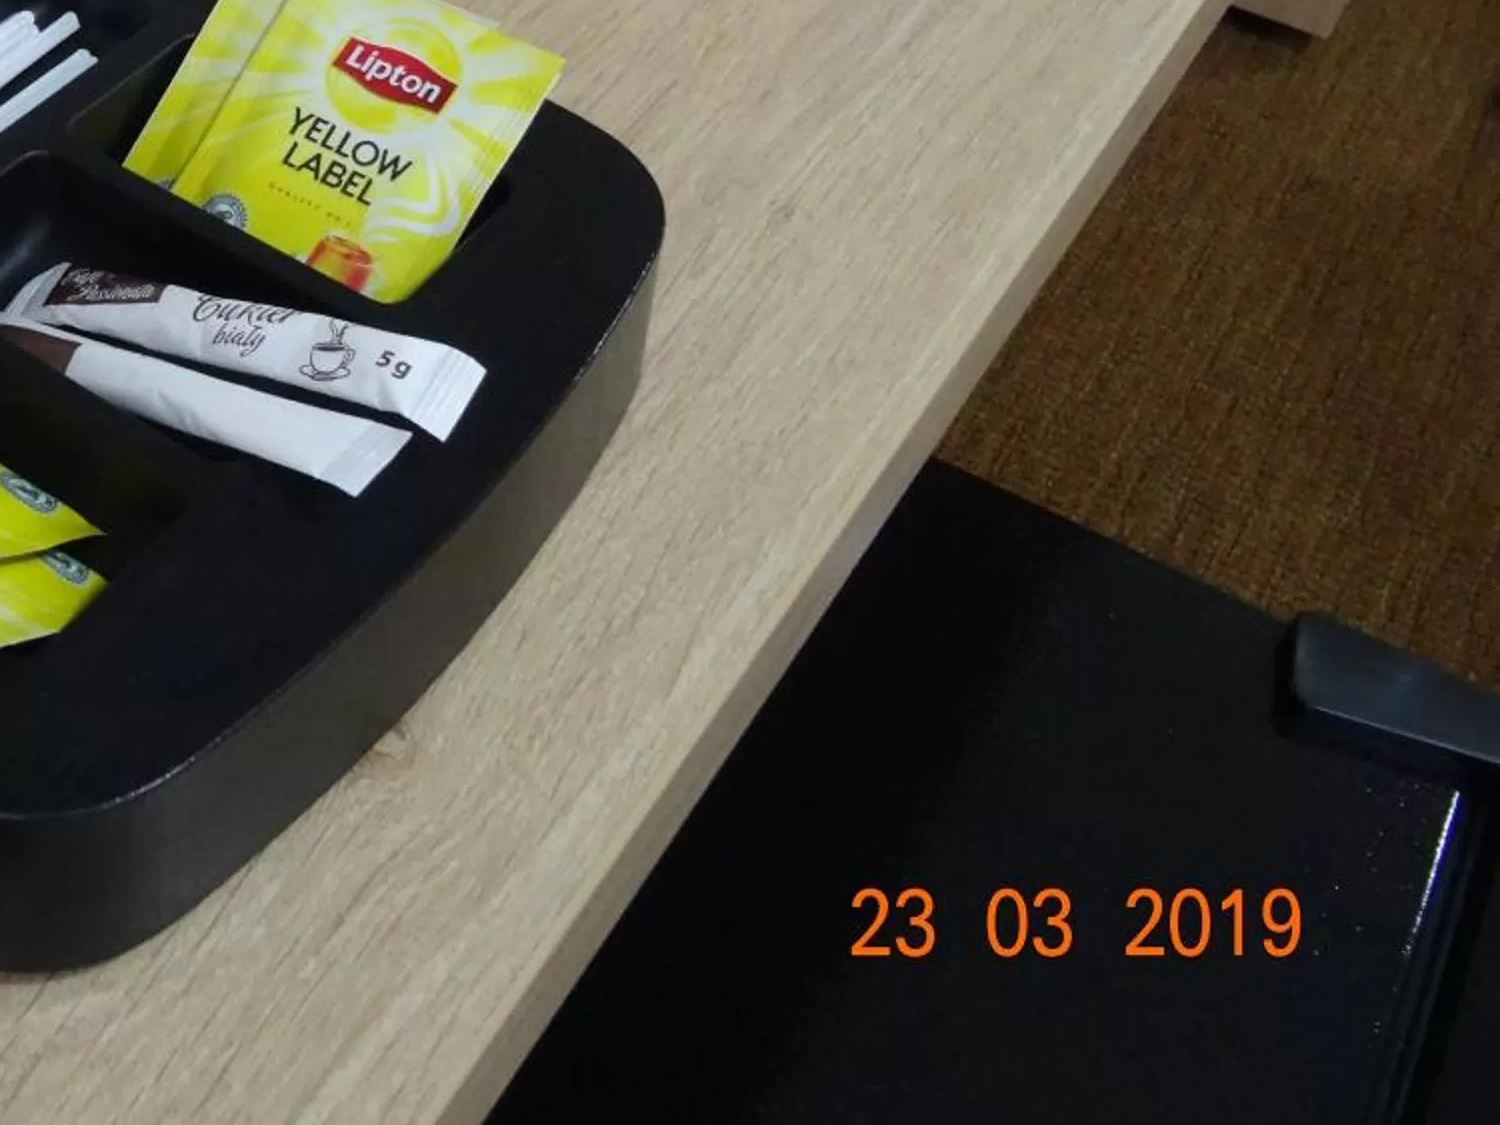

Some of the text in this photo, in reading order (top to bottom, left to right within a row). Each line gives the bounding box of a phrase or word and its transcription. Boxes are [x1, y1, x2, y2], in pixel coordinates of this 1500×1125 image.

[344, 43, 442, 105] Lipton
[281, 140, 374, 207] LABEL
[288, 106, 414, 183] YELLOW
